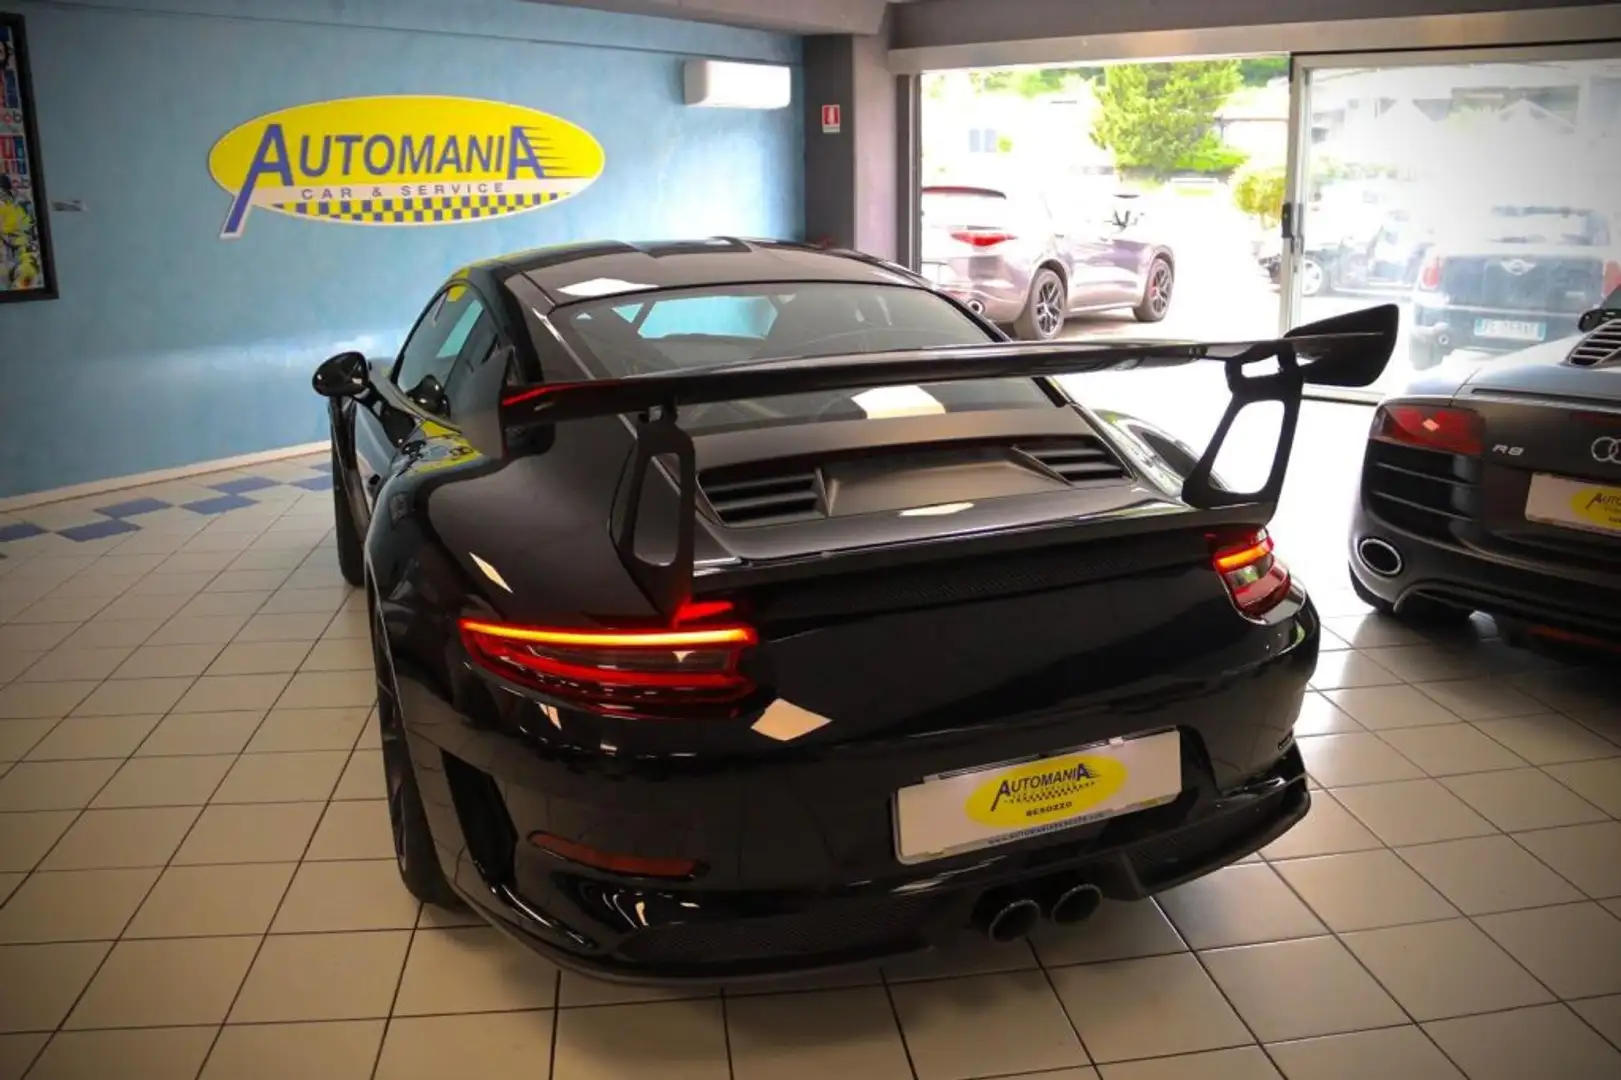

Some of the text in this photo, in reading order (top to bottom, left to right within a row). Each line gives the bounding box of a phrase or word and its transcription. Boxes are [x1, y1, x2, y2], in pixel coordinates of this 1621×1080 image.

[224, 123, 547, 233] AUTOMANIA
[301, 182, 504, 200] CAR & SERVICE
[1491, 443, 1525, 456] R8
[989, 763, 1092, 812] AUTOMANIA
